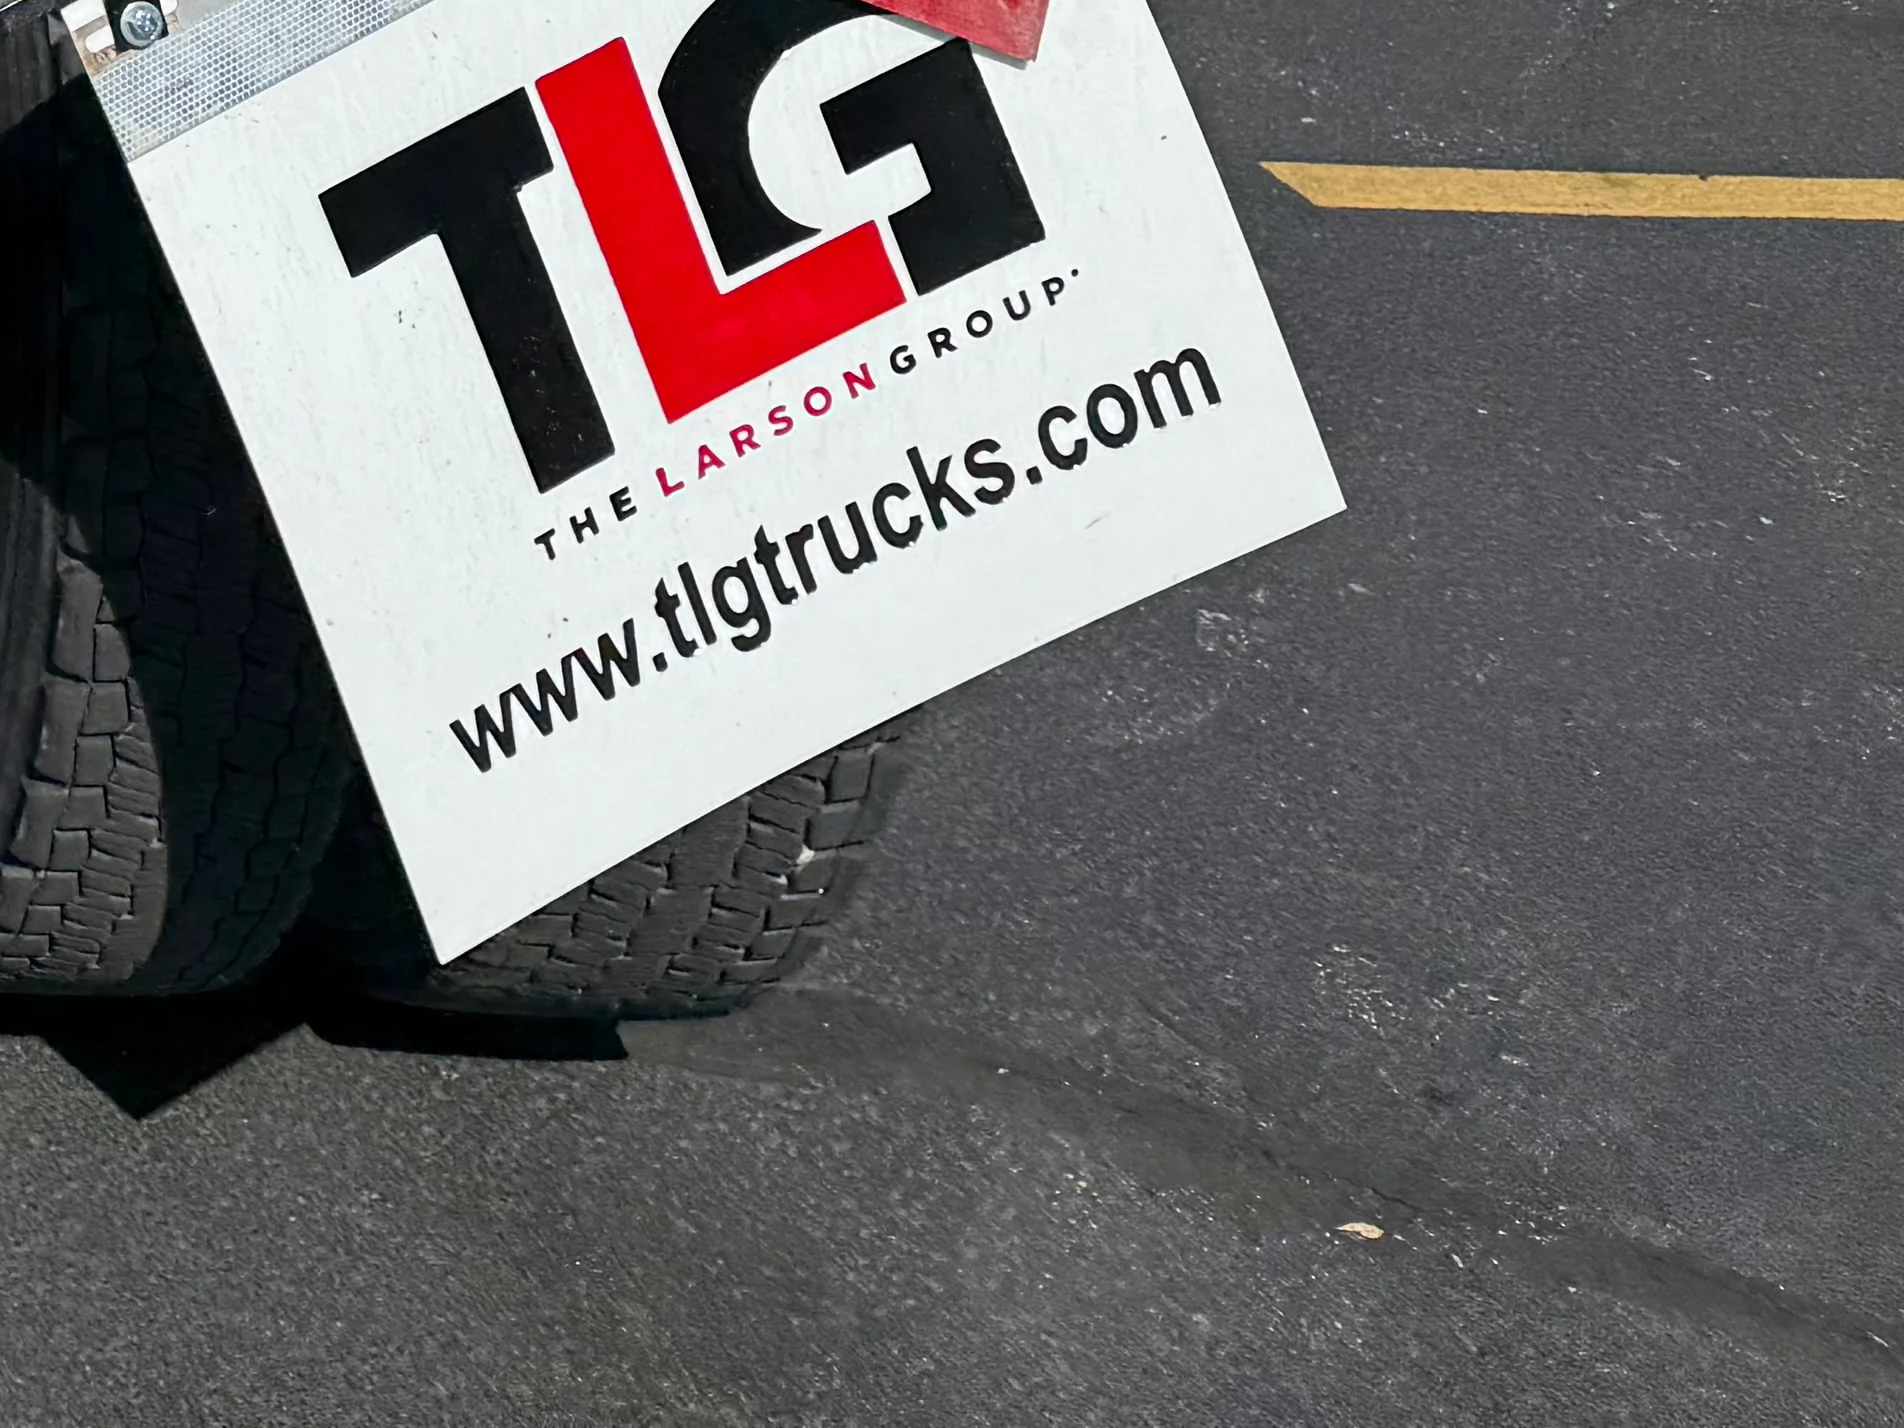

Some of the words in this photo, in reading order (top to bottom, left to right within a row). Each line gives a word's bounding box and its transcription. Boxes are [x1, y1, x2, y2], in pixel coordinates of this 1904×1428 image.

[448, 347, 1222, 773] www.tlgtrucks.com
[533, 486, 638, 561] THE
[655, 362, 876, 498] LARSON
[888, 276, 1066, 375] GROUP
